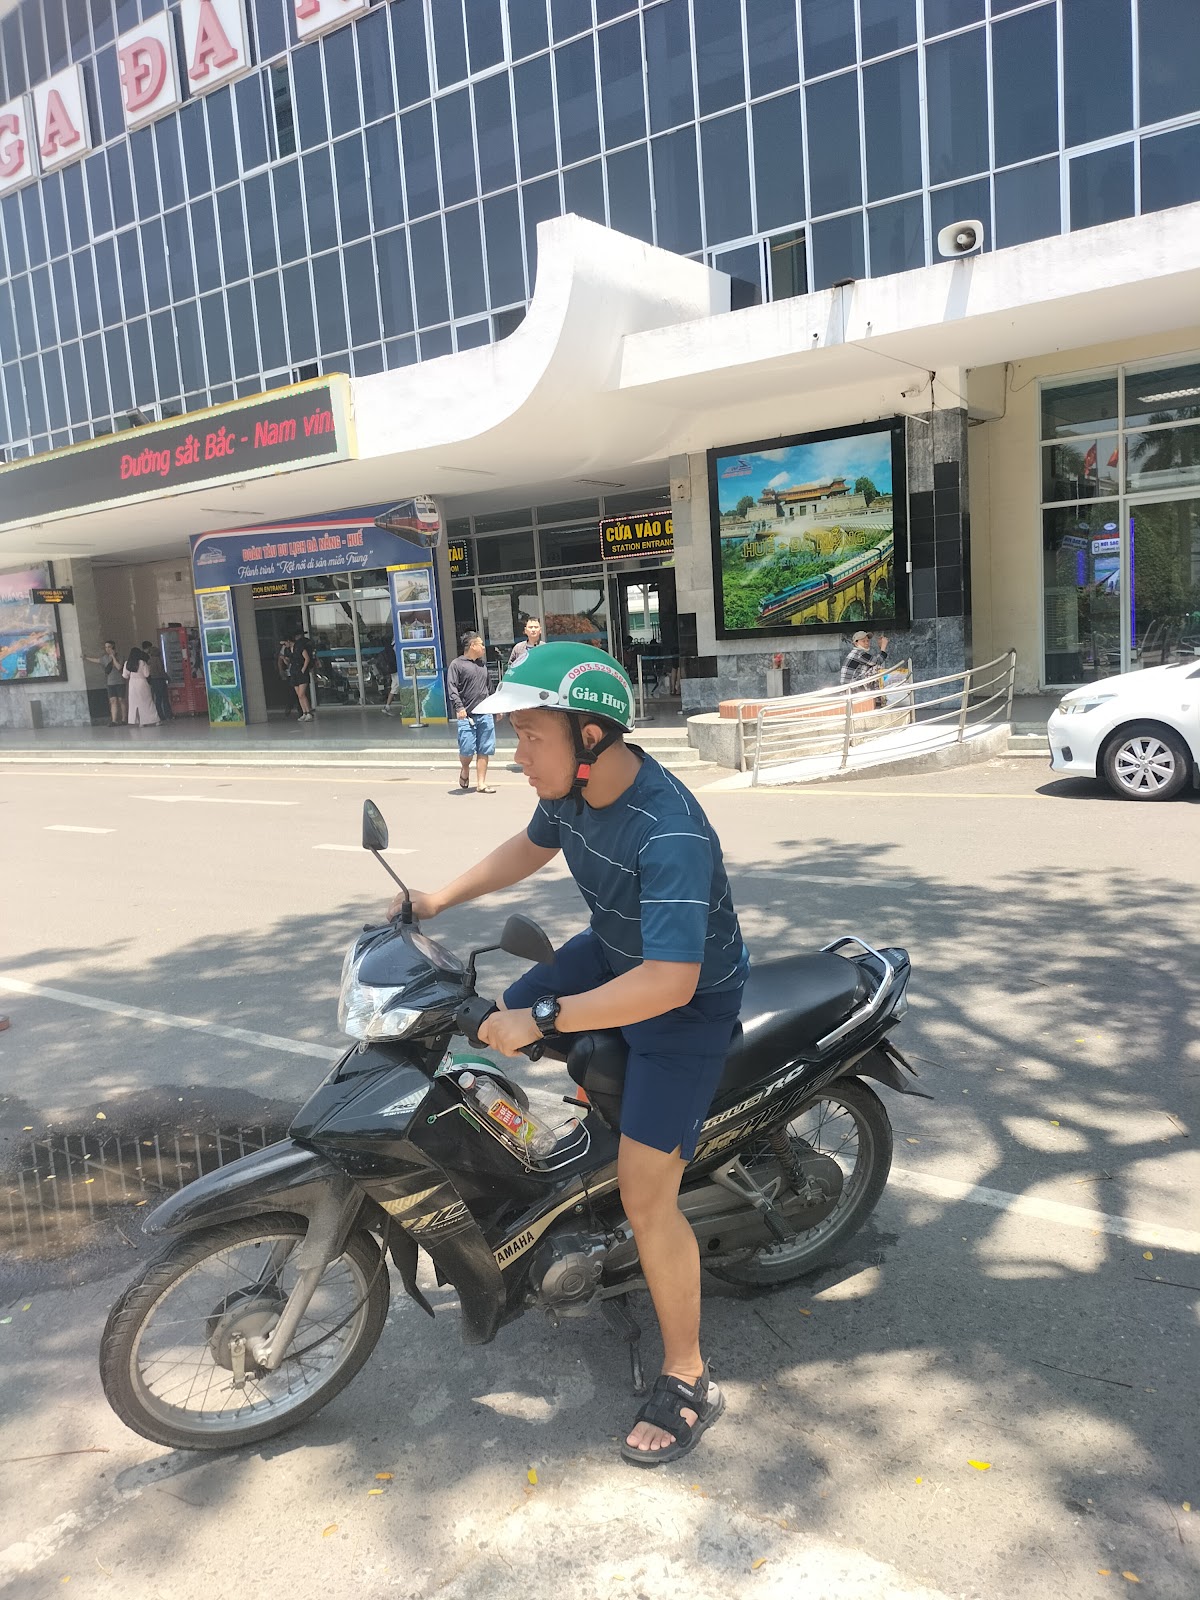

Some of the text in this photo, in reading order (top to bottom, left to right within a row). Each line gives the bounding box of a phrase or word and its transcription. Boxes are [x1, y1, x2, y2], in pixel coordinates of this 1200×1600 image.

[120, 448, 171, 480] Đường
[175, 434, 200, 466] sắt
[205, 426, 235, 461] Bắc
[254, 418, 296, 448] Nam
[606, 519, 674, 542] CỬA VÀO G
[242, 545, 263, 562] ĐOÀN
[263, 543, 277, 559] TÀU
[277, 543, 288, 557] DU
[289, 539, 306, 558] LỊCH
[306, 536, 318, 553] ĐÀ
[318, 533, 341, 551] NẴNG
[346, 528, 364, 548] HUẾ
[448, 546, 464, 562] TÀU
[612, 538, 674, 553] STATION ENTRANC
[238, 566, 259, 579] Hành
[259, 562, 276, 575] trình
[295, 558, 307, 571] nối
[314, 557, 327, 568] sản
[327, 554, 345, 566] miền
[252, 583, 288, 594] TION ENTRANCE
[572, 687, 628, 714] Gia Huy
[700, 1091, 764, 1133] RIUS
[494, 1230, 535, 1264] AMAHA
